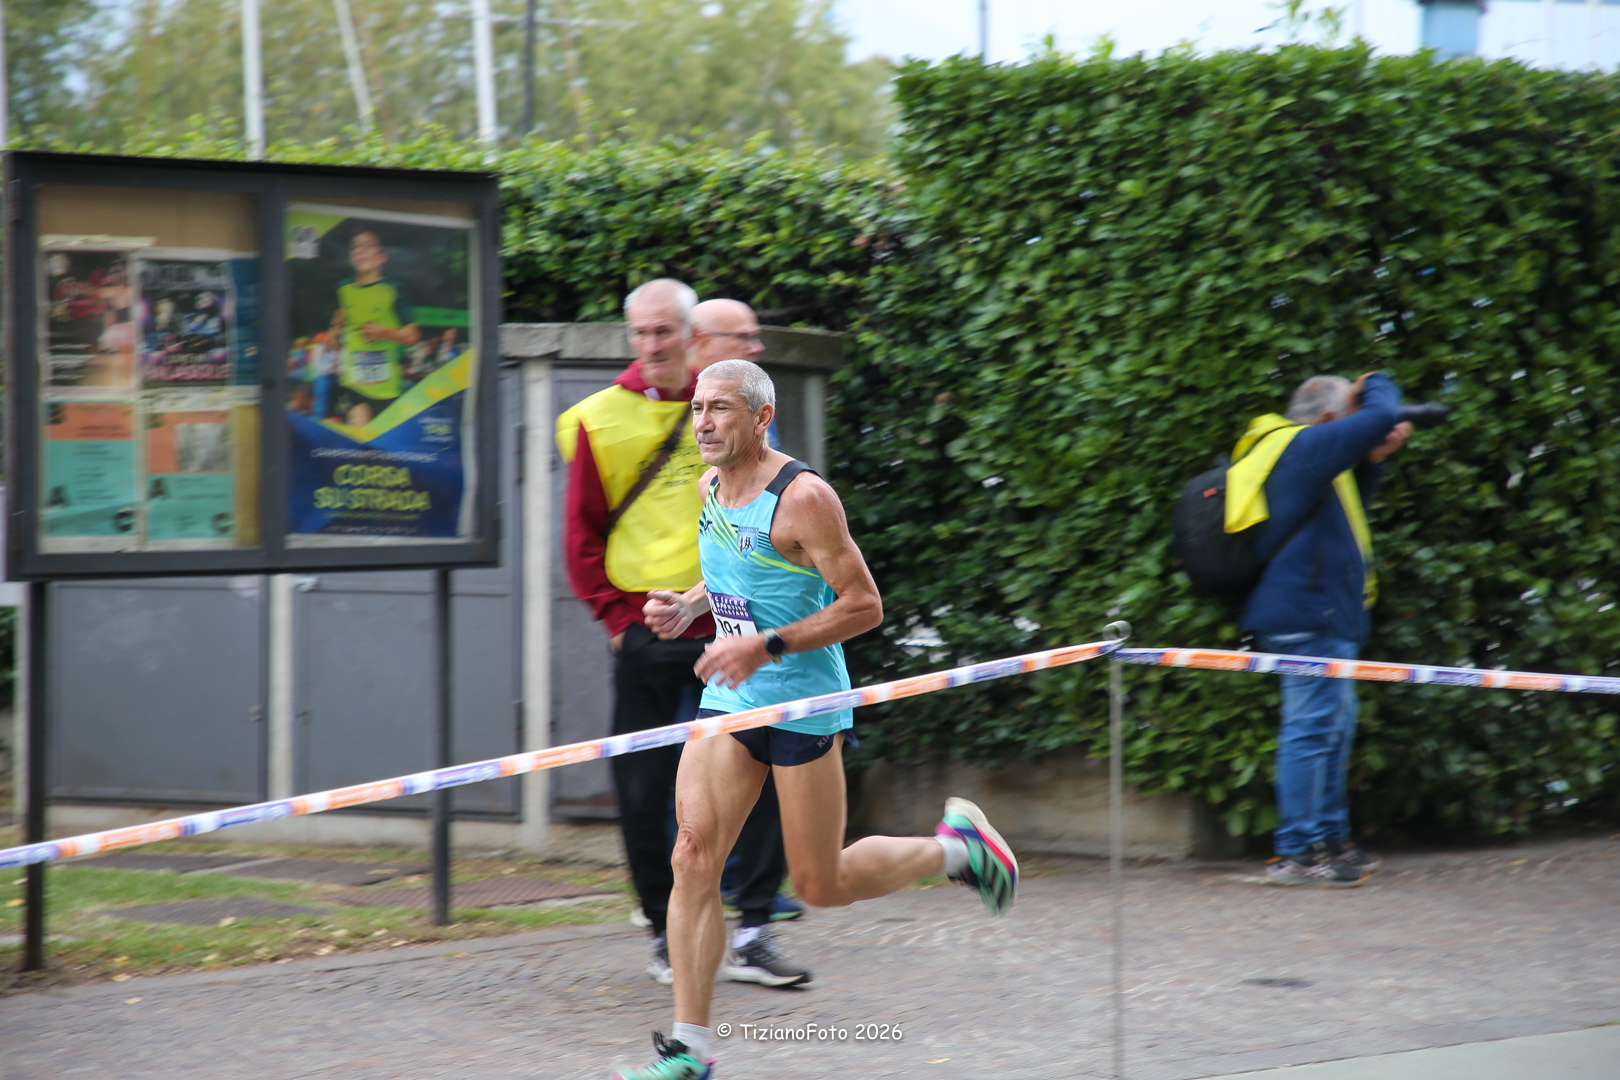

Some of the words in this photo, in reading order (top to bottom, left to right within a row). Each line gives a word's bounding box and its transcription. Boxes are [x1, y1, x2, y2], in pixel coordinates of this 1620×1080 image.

[332, 463, 413, 488] CORSA
[313, 485, 349, 509] SU
[347, 487, 433, 512] STRADA
